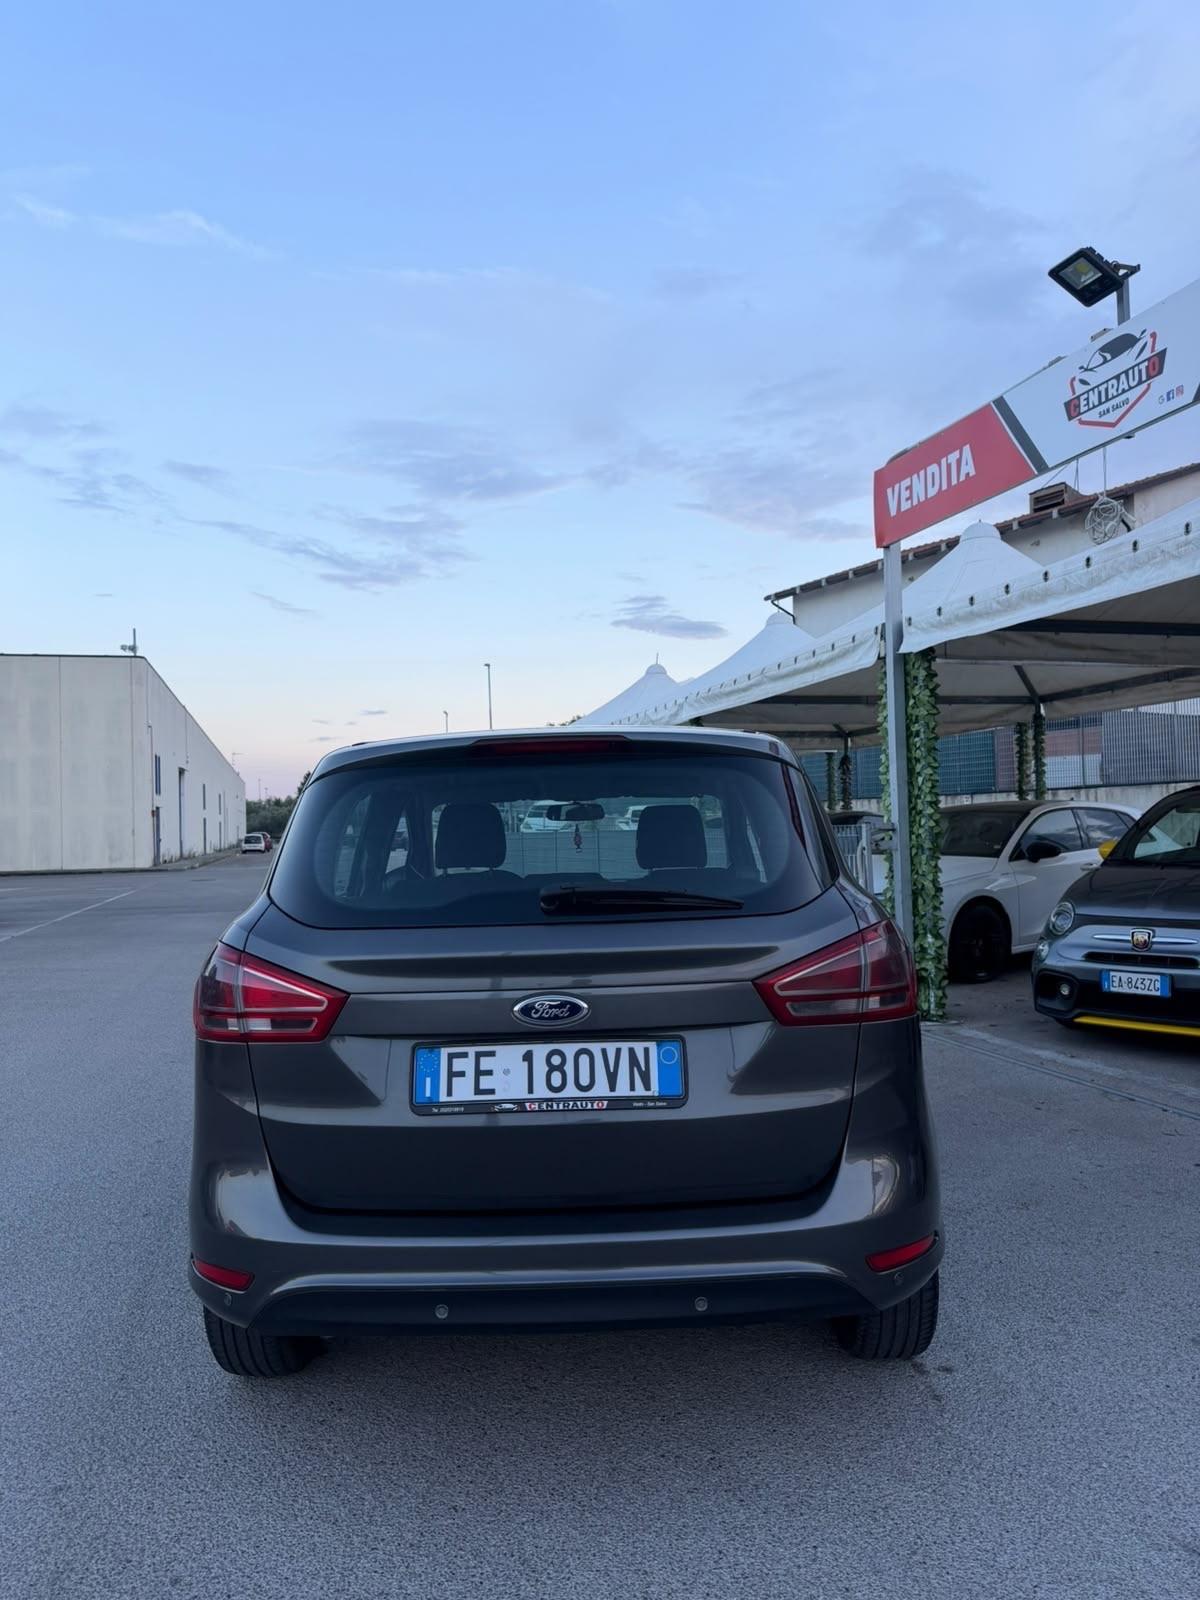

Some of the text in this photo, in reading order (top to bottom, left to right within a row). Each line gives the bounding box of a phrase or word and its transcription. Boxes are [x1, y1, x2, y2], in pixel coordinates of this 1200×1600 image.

[1069, 355, 1160, 417] CENTRAUTO
[1098, 398, 1130, 418] SAN SALVO
[886, 444, 976, 518] VENDITA
[531, 1001, 570, 1018] Ford
[446, 1047, 651, 1097] FE 180VN
[527, 1100, 605, 1111] CENTRAUTO
